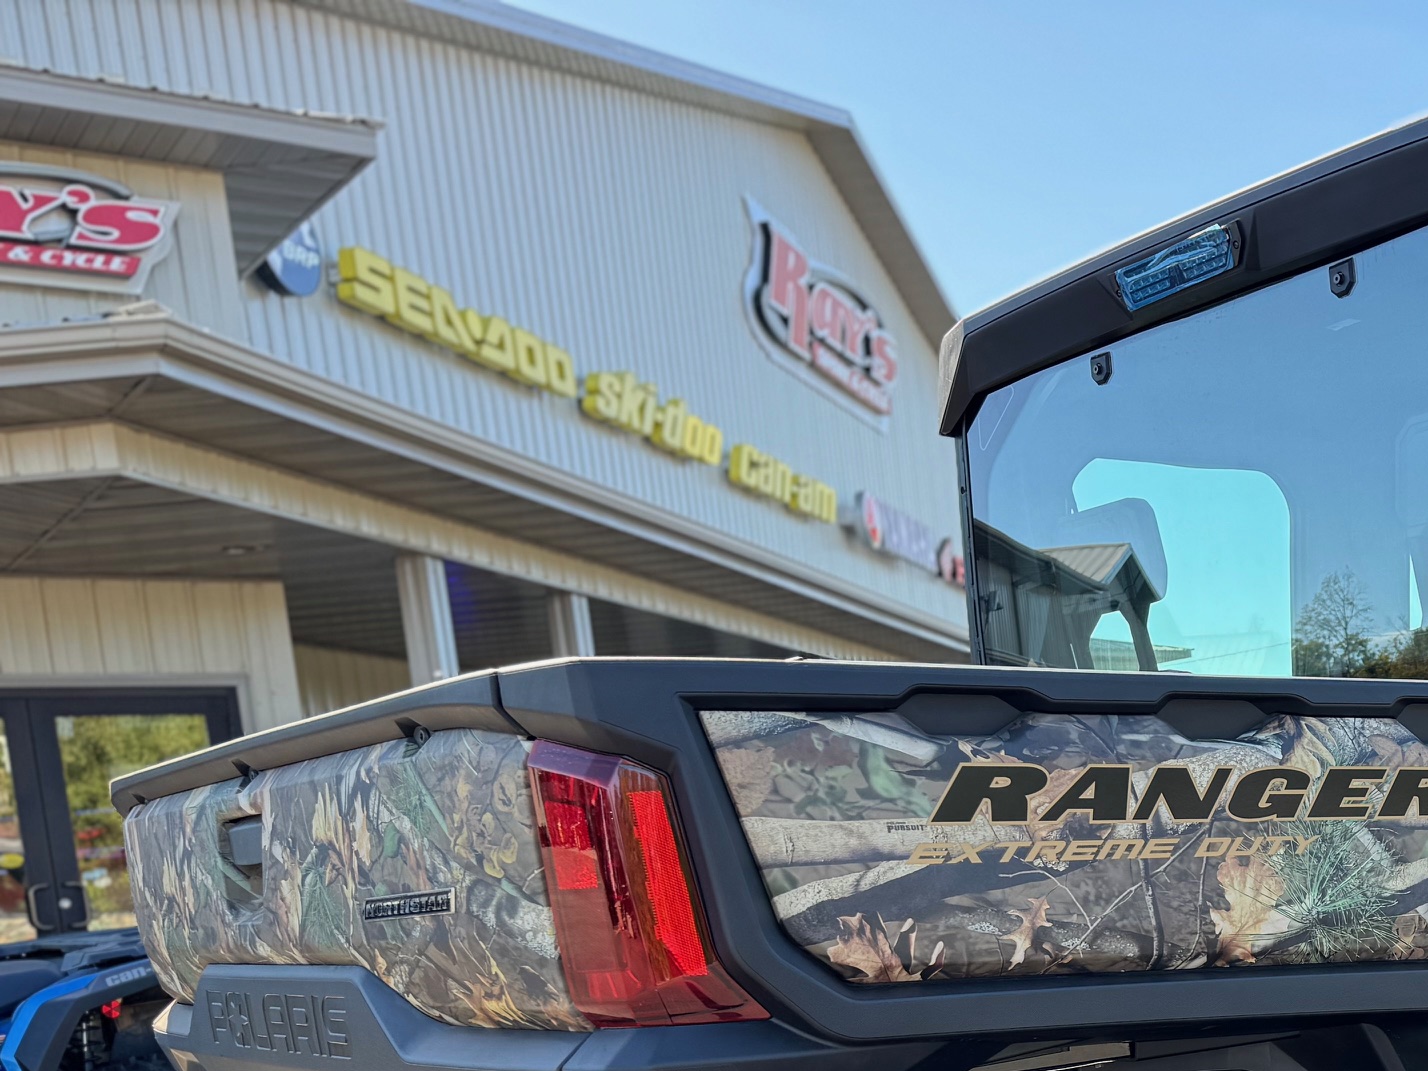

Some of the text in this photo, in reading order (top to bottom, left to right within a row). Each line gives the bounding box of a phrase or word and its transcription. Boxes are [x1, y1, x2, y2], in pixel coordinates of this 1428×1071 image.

[40, 249, 131, 272] CYCLE
[905, 834, 1319, 864] EXTREME DUTY
[206, 989, 352, 1060] POLARIS
